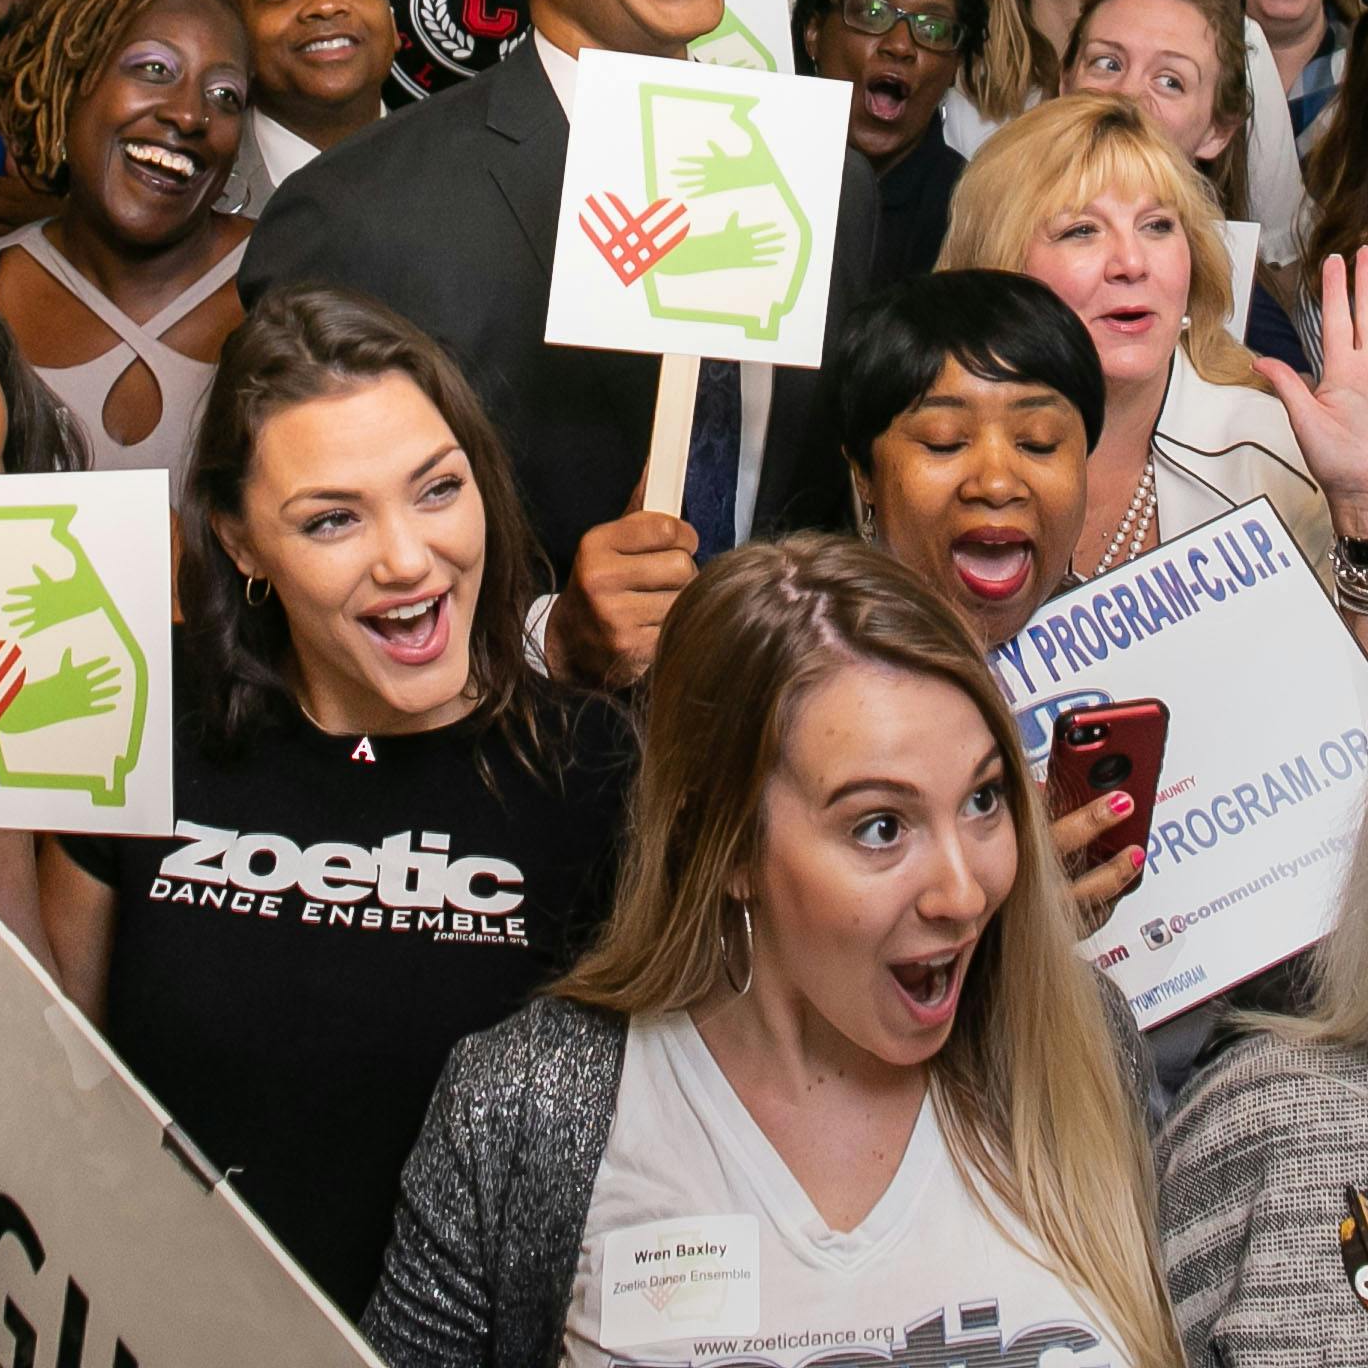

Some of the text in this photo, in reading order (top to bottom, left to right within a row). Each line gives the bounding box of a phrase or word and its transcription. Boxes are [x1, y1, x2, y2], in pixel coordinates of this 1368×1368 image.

[1028, 518, 1292, 682] PROGRAM-C.U.P.
[349, 735, 378, 764] A
[158, 819, 524, 917] zoetic
[148, 877, 526, 937] DANCE ENSEMBLE
[433, 931, 529, 948] zoeticdance.org
[1129, 963, 1209, 1016] TYUNITYPROGRAM
[634, 1242, 728, 1265] Wren Baxley
[613, 1268, 752, 1296] Zoetic Dance Ensemble
[692, 1325, 896, 1357] www.zoeticdance.org
